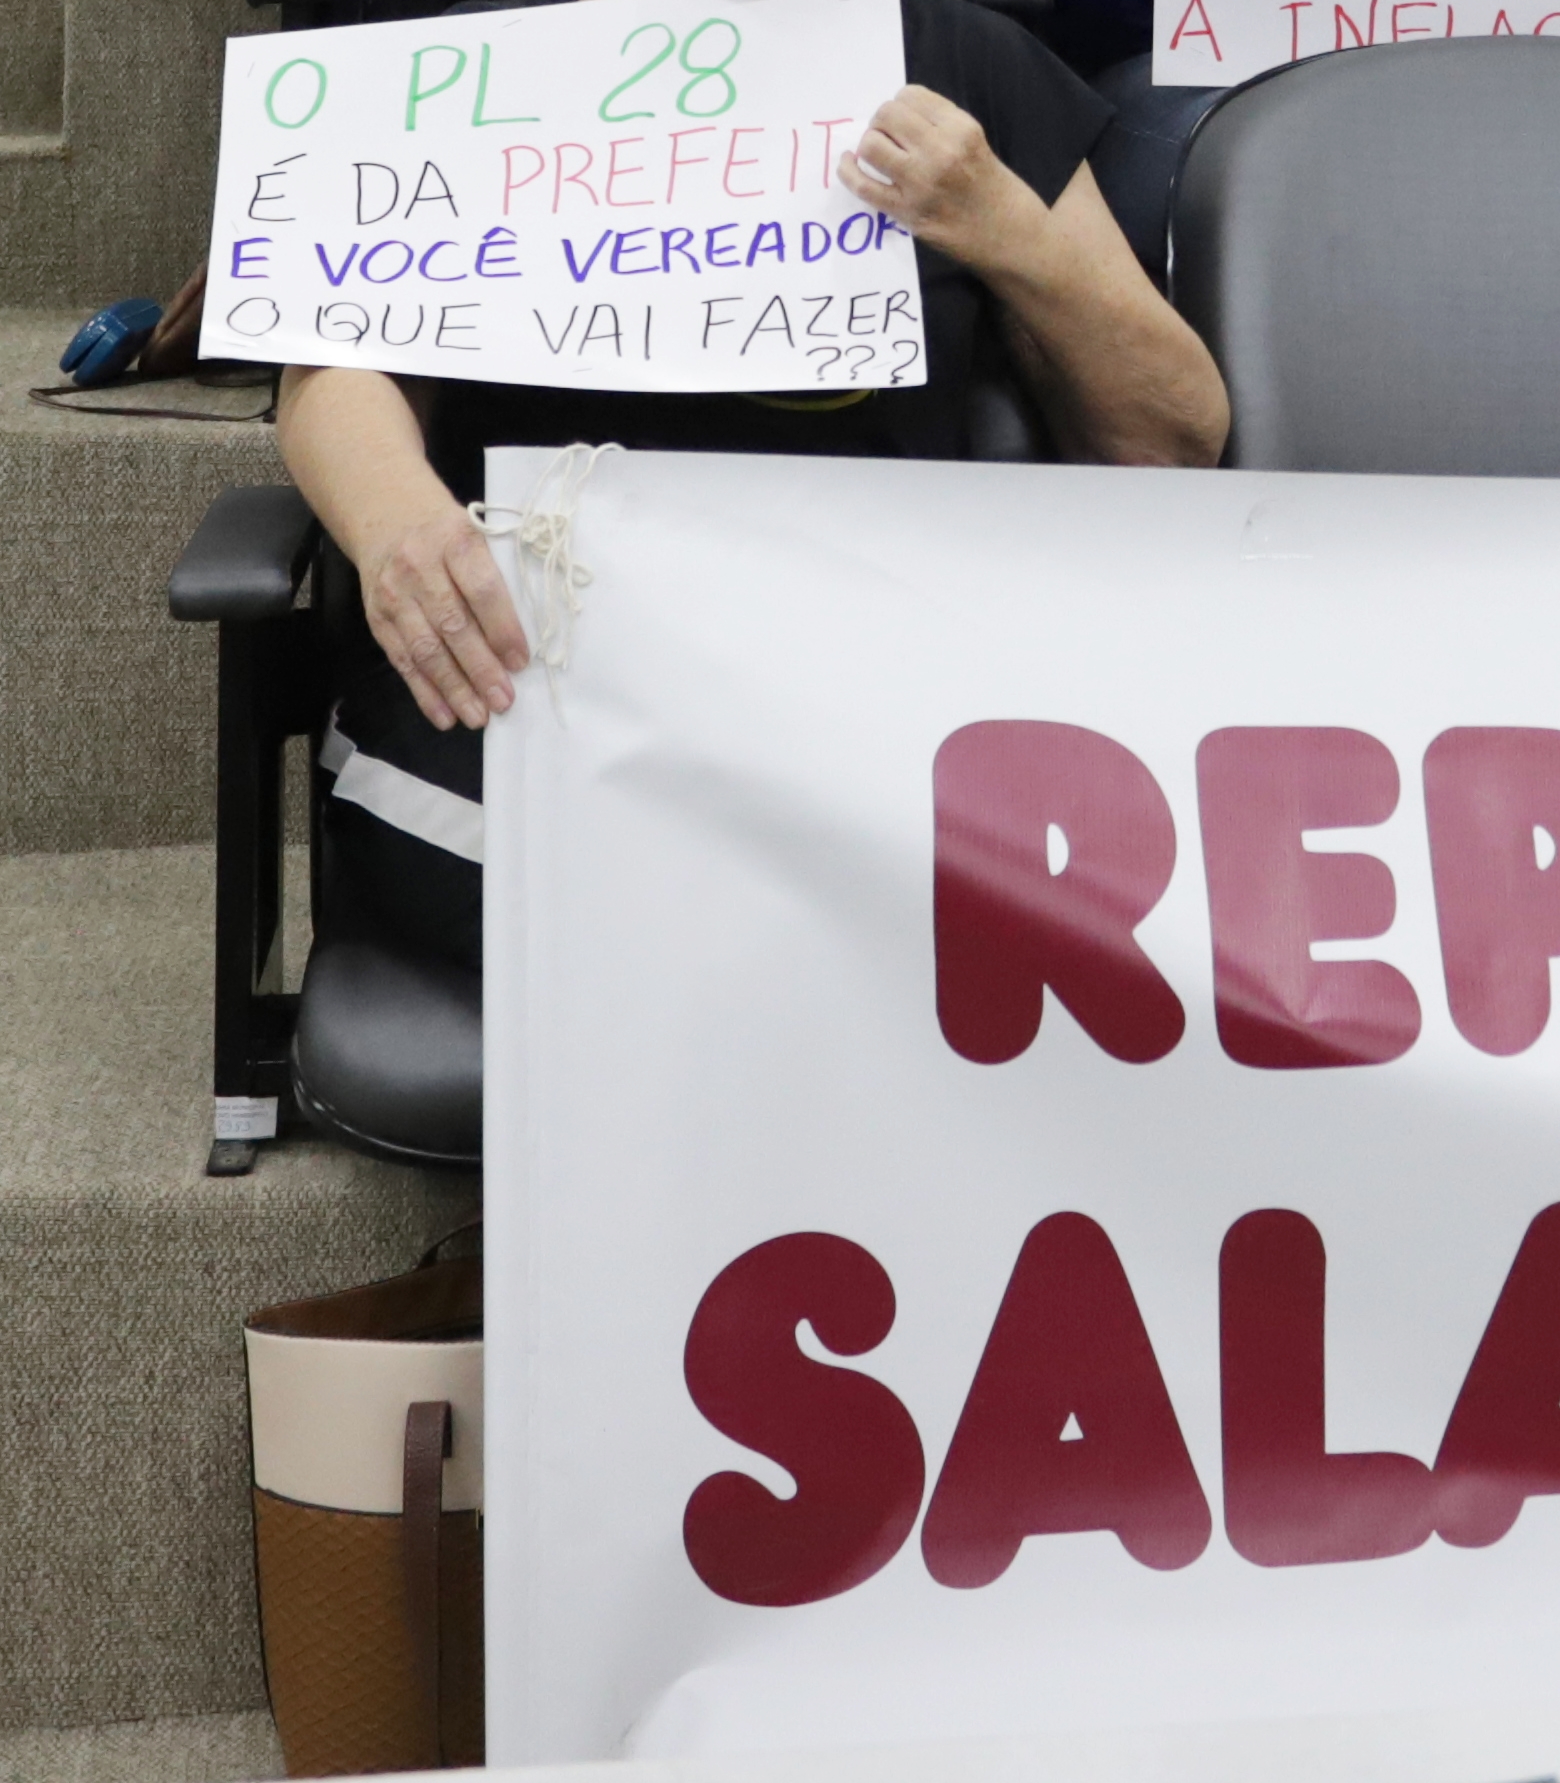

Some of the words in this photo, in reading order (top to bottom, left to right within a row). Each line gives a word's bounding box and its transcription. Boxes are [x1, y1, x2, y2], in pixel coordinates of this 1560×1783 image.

[264, 57, 328, 129] O
[405, 42, 541, 131] PL
[597, 17, 742, 124] 28
[247, 152, 307, 222] É
[354, 159, 459, 226] DA
[501, 117, 854, 217] PREFEIT
[230, 237, 274, 280] E
[315, 226, 524, 286] VOCÊ
[227, 297, 281, 338] O
[315, 302, 483, 350] QUE
[531, 303, 652, 361] VAI
[701, 289, 920, 357] FAZER
[806, 340, 921, 386] ???
